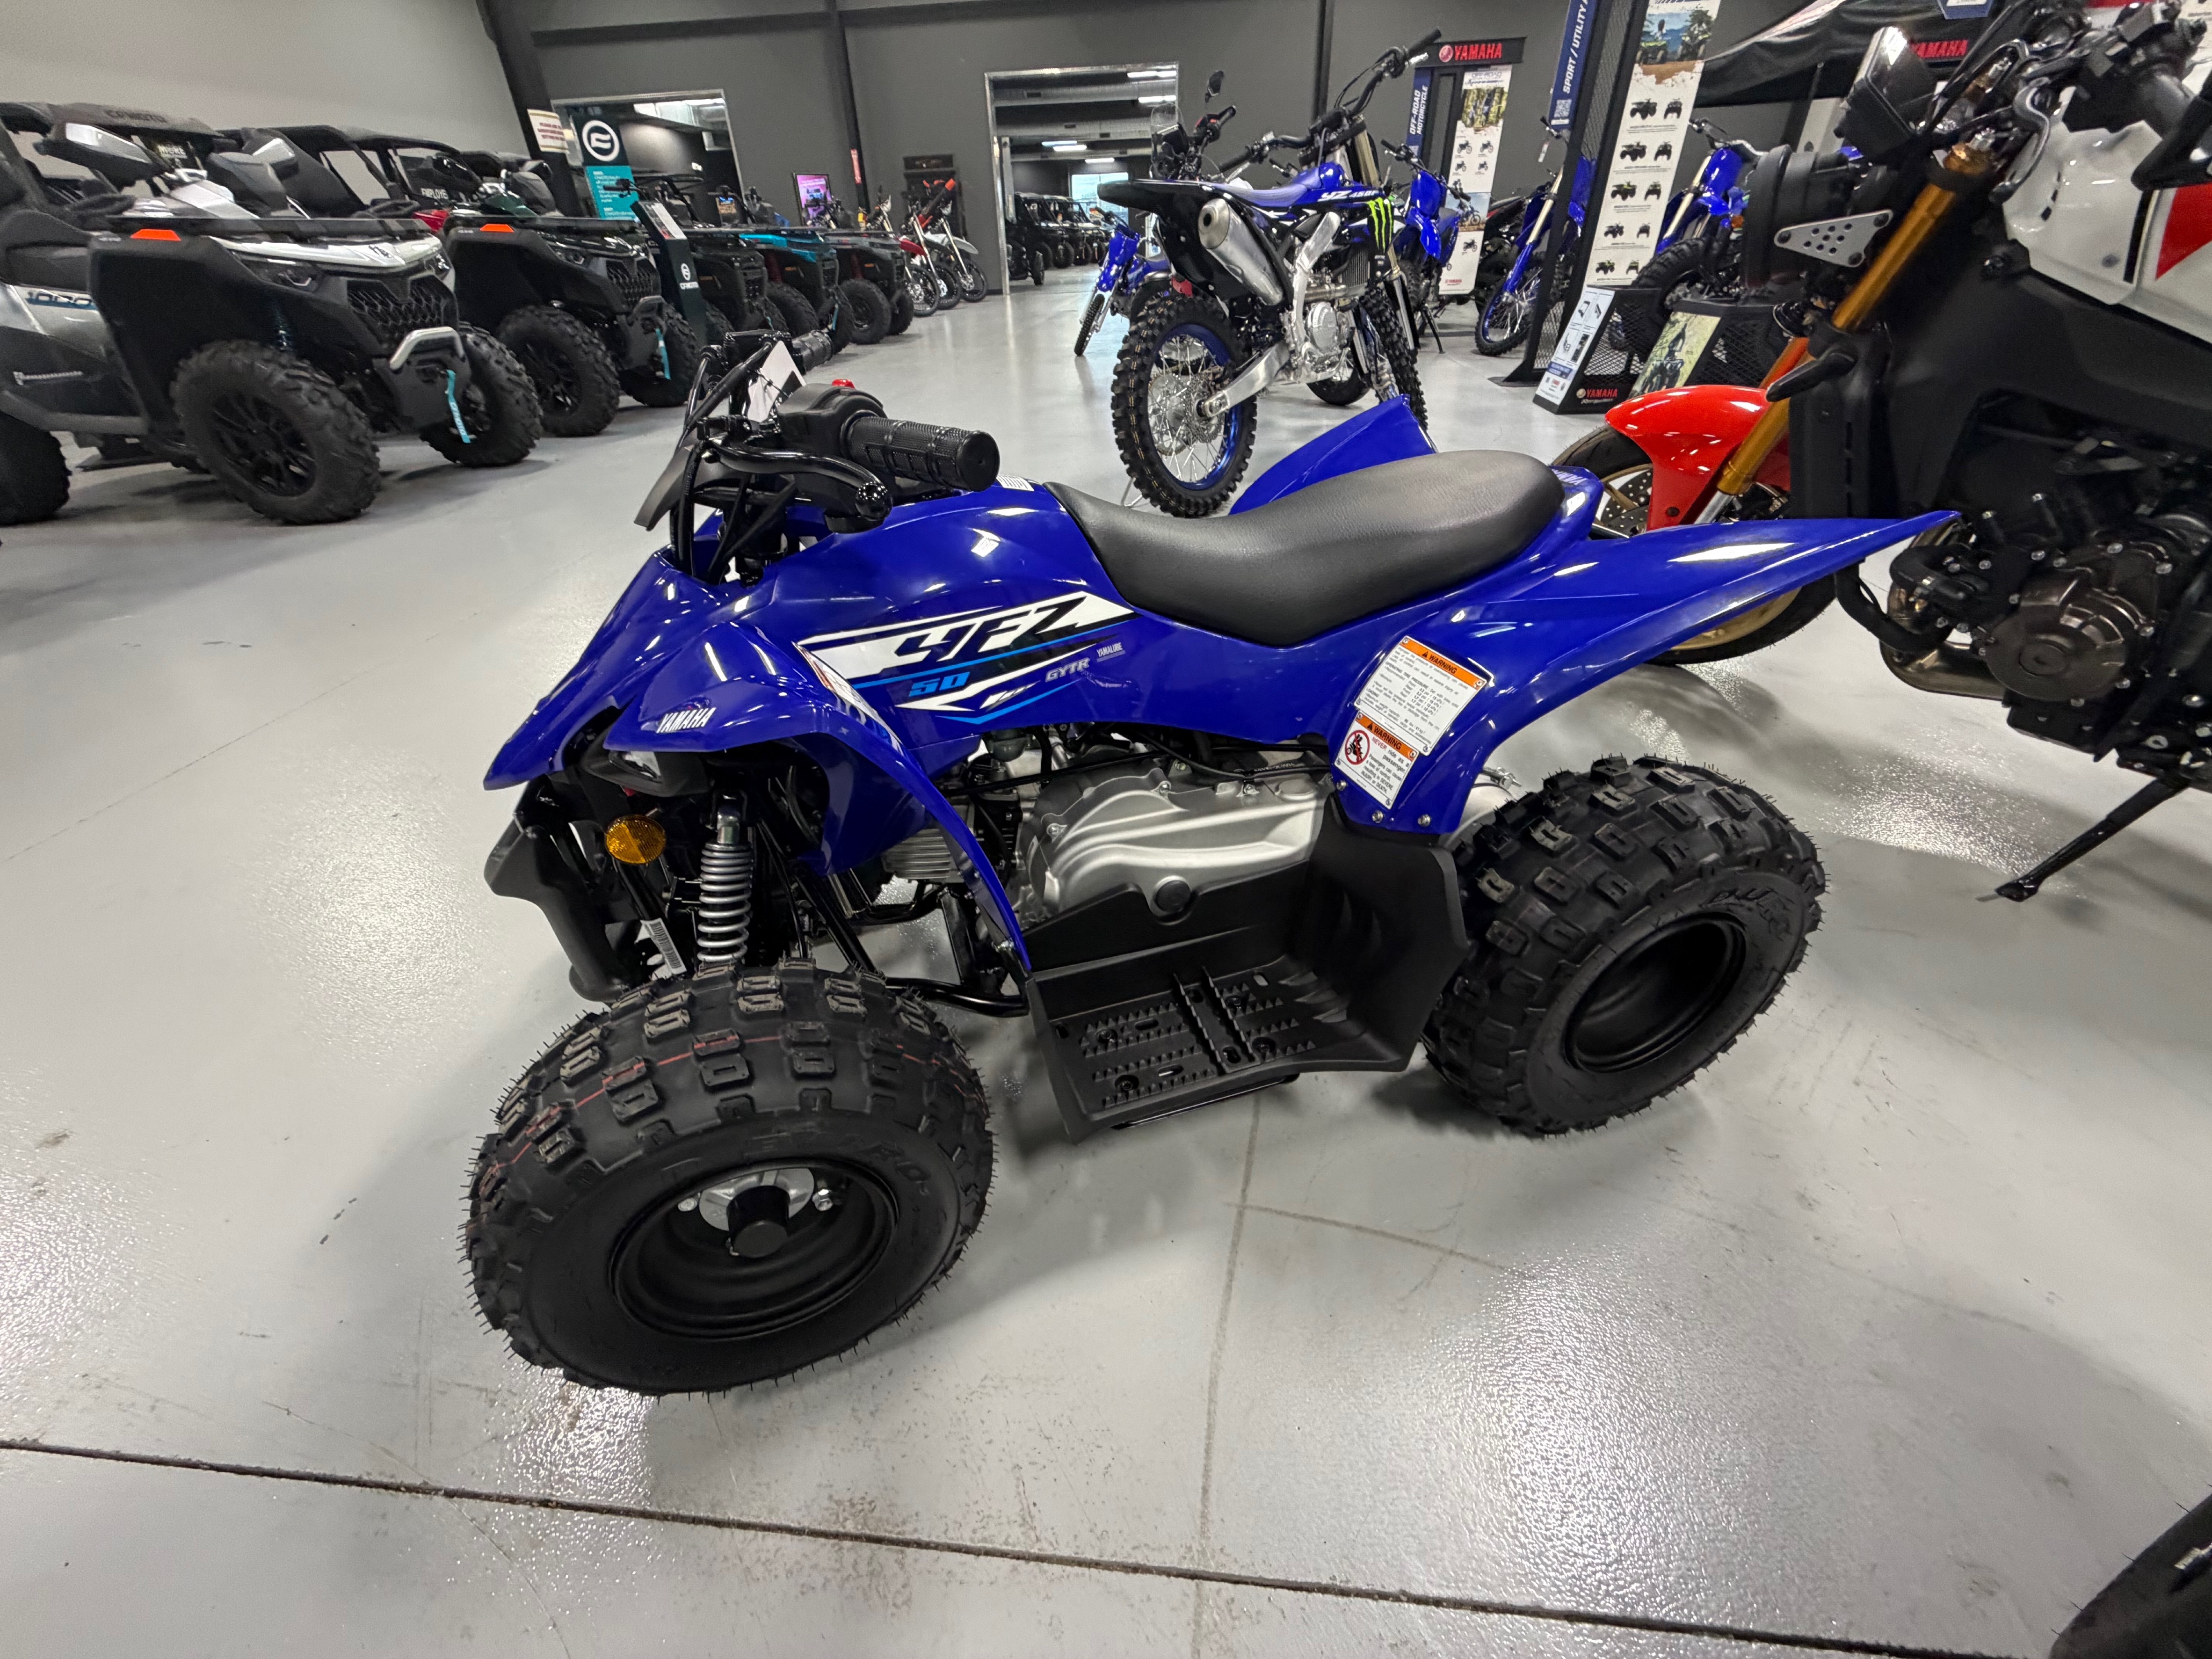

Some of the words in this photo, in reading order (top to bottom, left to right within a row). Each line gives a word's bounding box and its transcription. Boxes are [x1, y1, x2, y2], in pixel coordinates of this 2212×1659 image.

[1454, 43, 1502, 61] YAMAHA
[1563, 57, 1576, 94] SPORT
[1572, 4, 1588, 49] UTILITY
[1409, 89, 1421, 135] OFF-ROAD
[1416, 85, 1429, 135] MOTORCYCLE
[421, 188, 449, 200] EMPLOYE
[1317, 190, 1352, 202] YZ
[1587, 388, 1618, 398] YAMAHA
[1096, 642, 1123, 657] YAMALUBE
[1045, 657, 1090, 683] GYTR
[1428, 654, 1458, 674] WARNING
[908, 671, 970, 697] 50
[656, 707, 717, 734] YAMAHA
[1371, 736, 1387, 750] NEVER
[1387, 749, 1397, 758] ride
[1373, 726, 1402, 750] WARNING
[1368, 754, 1385, 770] Passengers
[1392, 771, 1402, 781] cause
[1382, 754, 1406, 775] passenger.
[1361, 770, 1372, 781] INJURY
[1376, 782, 1388, 793] DEATH.
[1363, 765, 1377, 778] resulting
[1380, 777, 1393, 790] SEVERE
